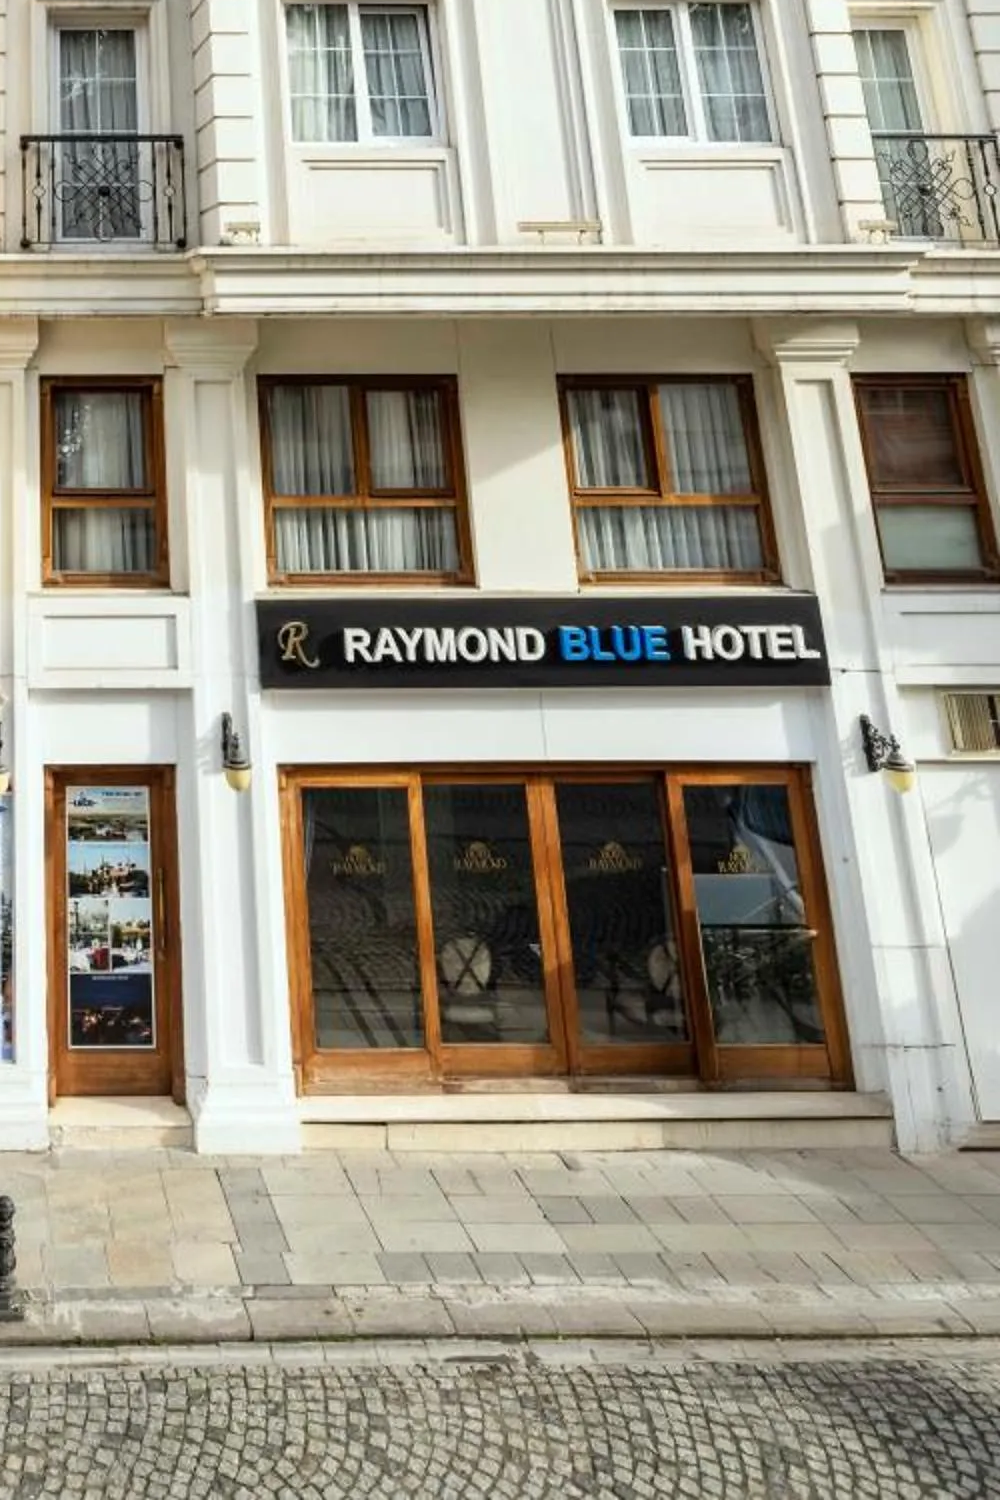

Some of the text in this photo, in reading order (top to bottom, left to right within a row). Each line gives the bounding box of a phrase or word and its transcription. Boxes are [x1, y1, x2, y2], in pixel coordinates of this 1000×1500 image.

[278, 621, 821, 668] R RAYMOND BLUE HOTEL
